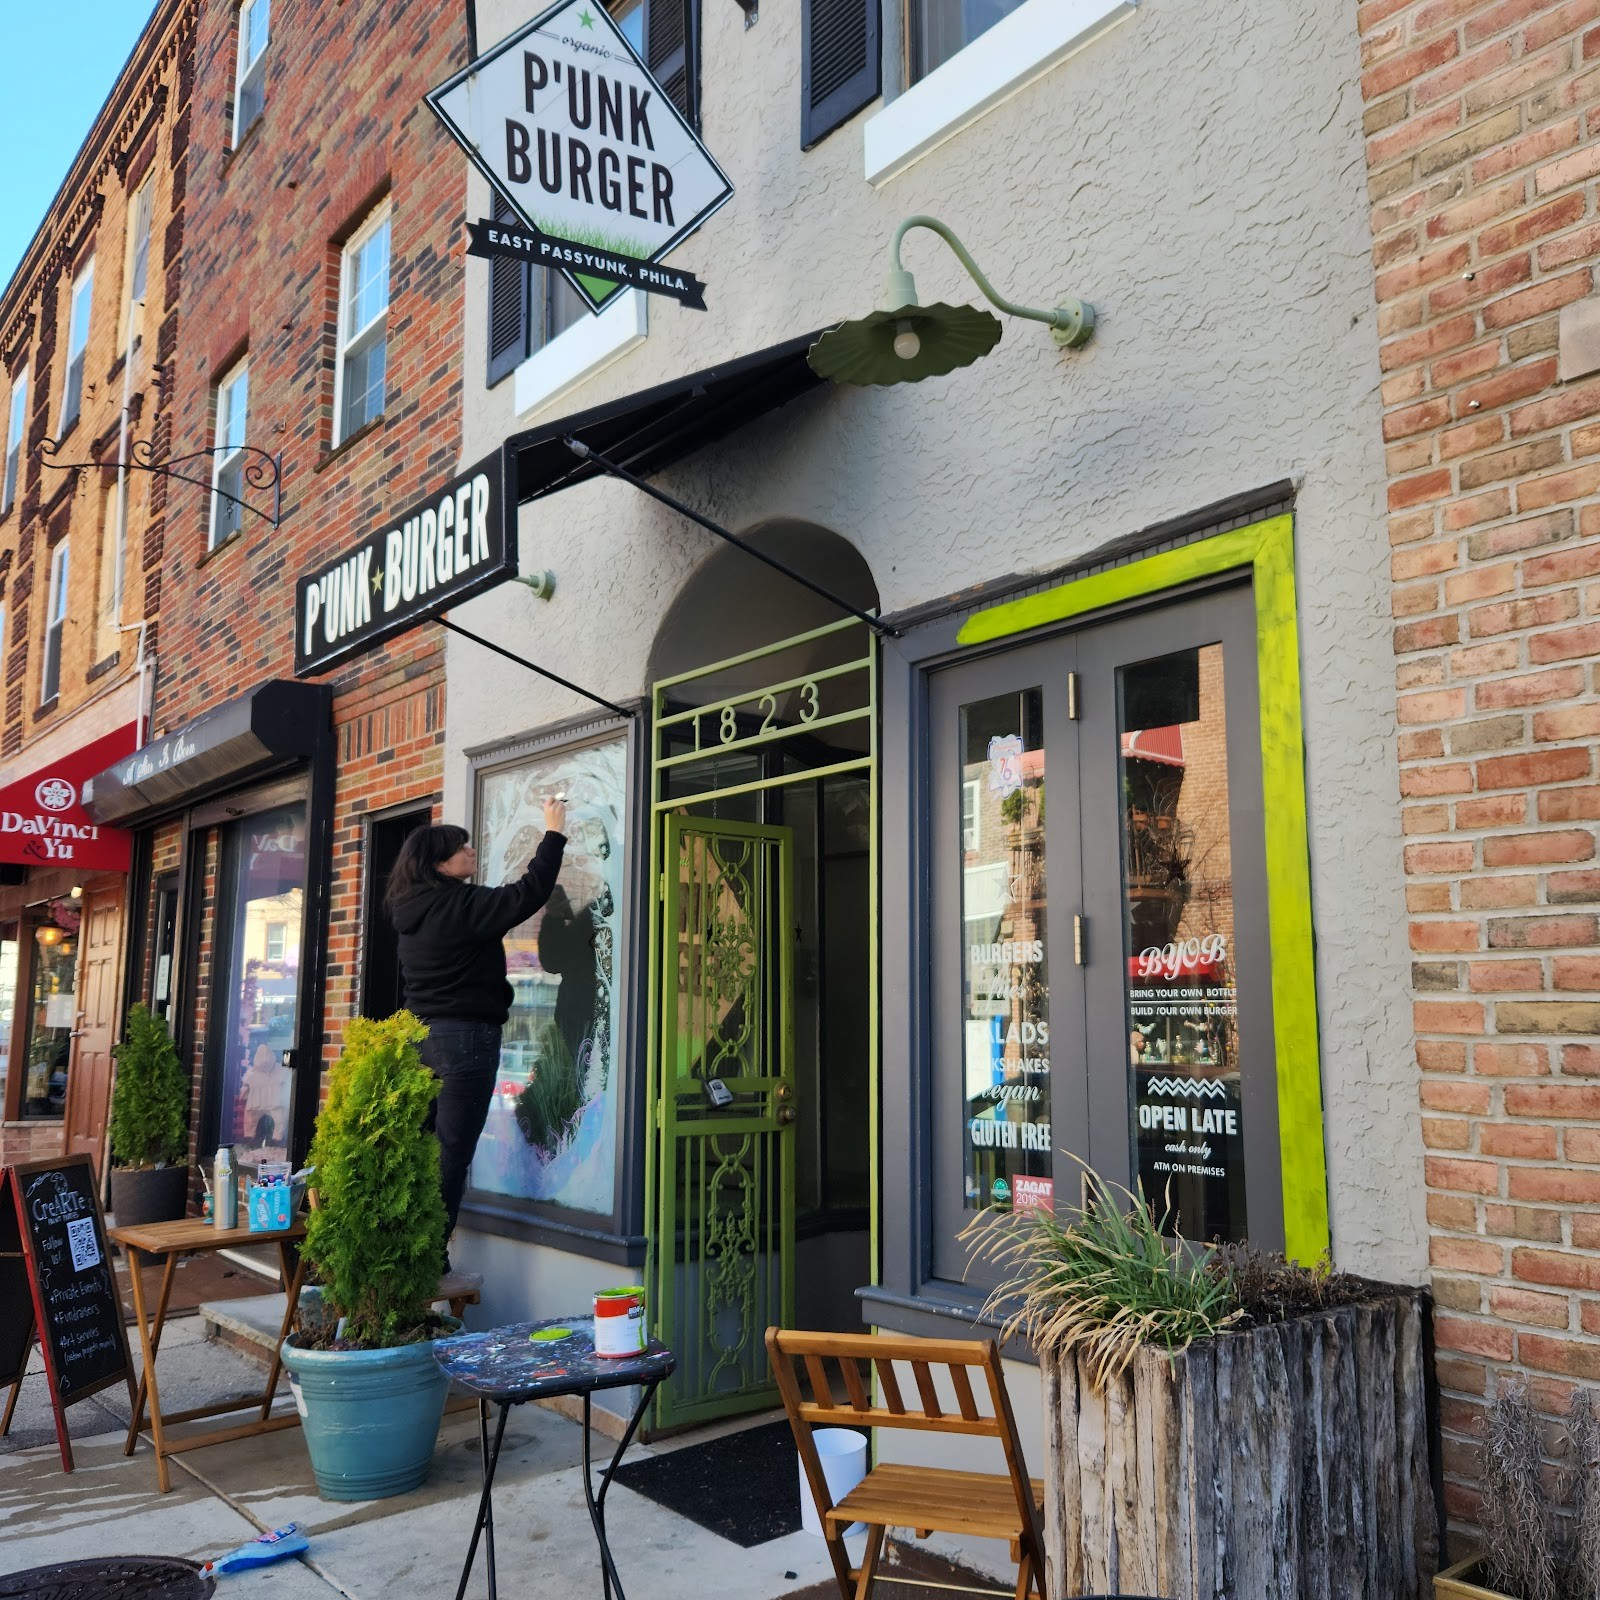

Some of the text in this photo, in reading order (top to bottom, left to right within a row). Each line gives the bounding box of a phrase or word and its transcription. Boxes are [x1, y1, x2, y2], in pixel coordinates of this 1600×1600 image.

[561, 36, 612, 59] organic
[523, 50, 655, 152] P'UNK
[505, 117, 676, 228] BURGER
[488, 229, 689, 291] EAST PASSYUNK, PHILA.
[304, 473, 490, 656] P'UNK BURGER
[692, 681, 820, 751] 1823
[0, 811, 99, 840] DaVinci
[43, 837, 75, 859] Yu
[970, 940, 1044, 964] BURGERS
[1138, 933, 1228, 981] BYOB
[1129, 987, 1237, 998] BRING YOUR OWN BOTTLE
[1130, 1006, 1154, 1016] BUILD
[1179, 1006, 1202, 1015] OWN
[1204, 1005, 1238, 1016] BURGER
[991, 1057, 1050, 1074] KSHAKES
[980, 1084, 1043, 1111] vegan
[1139, 1104, 1237, 1135] OPEN LATE
[971, 1119, 1052, 1152] GLUTEN FREE
[1164, 1139, 1212, 1160] cash only
[1153, 1161, 1226, 1177] ATM ON PREMISES
[1015, 1180, 1053, 1197] ZAGAT
[1016, 1193, 1039, 1206] 2016
